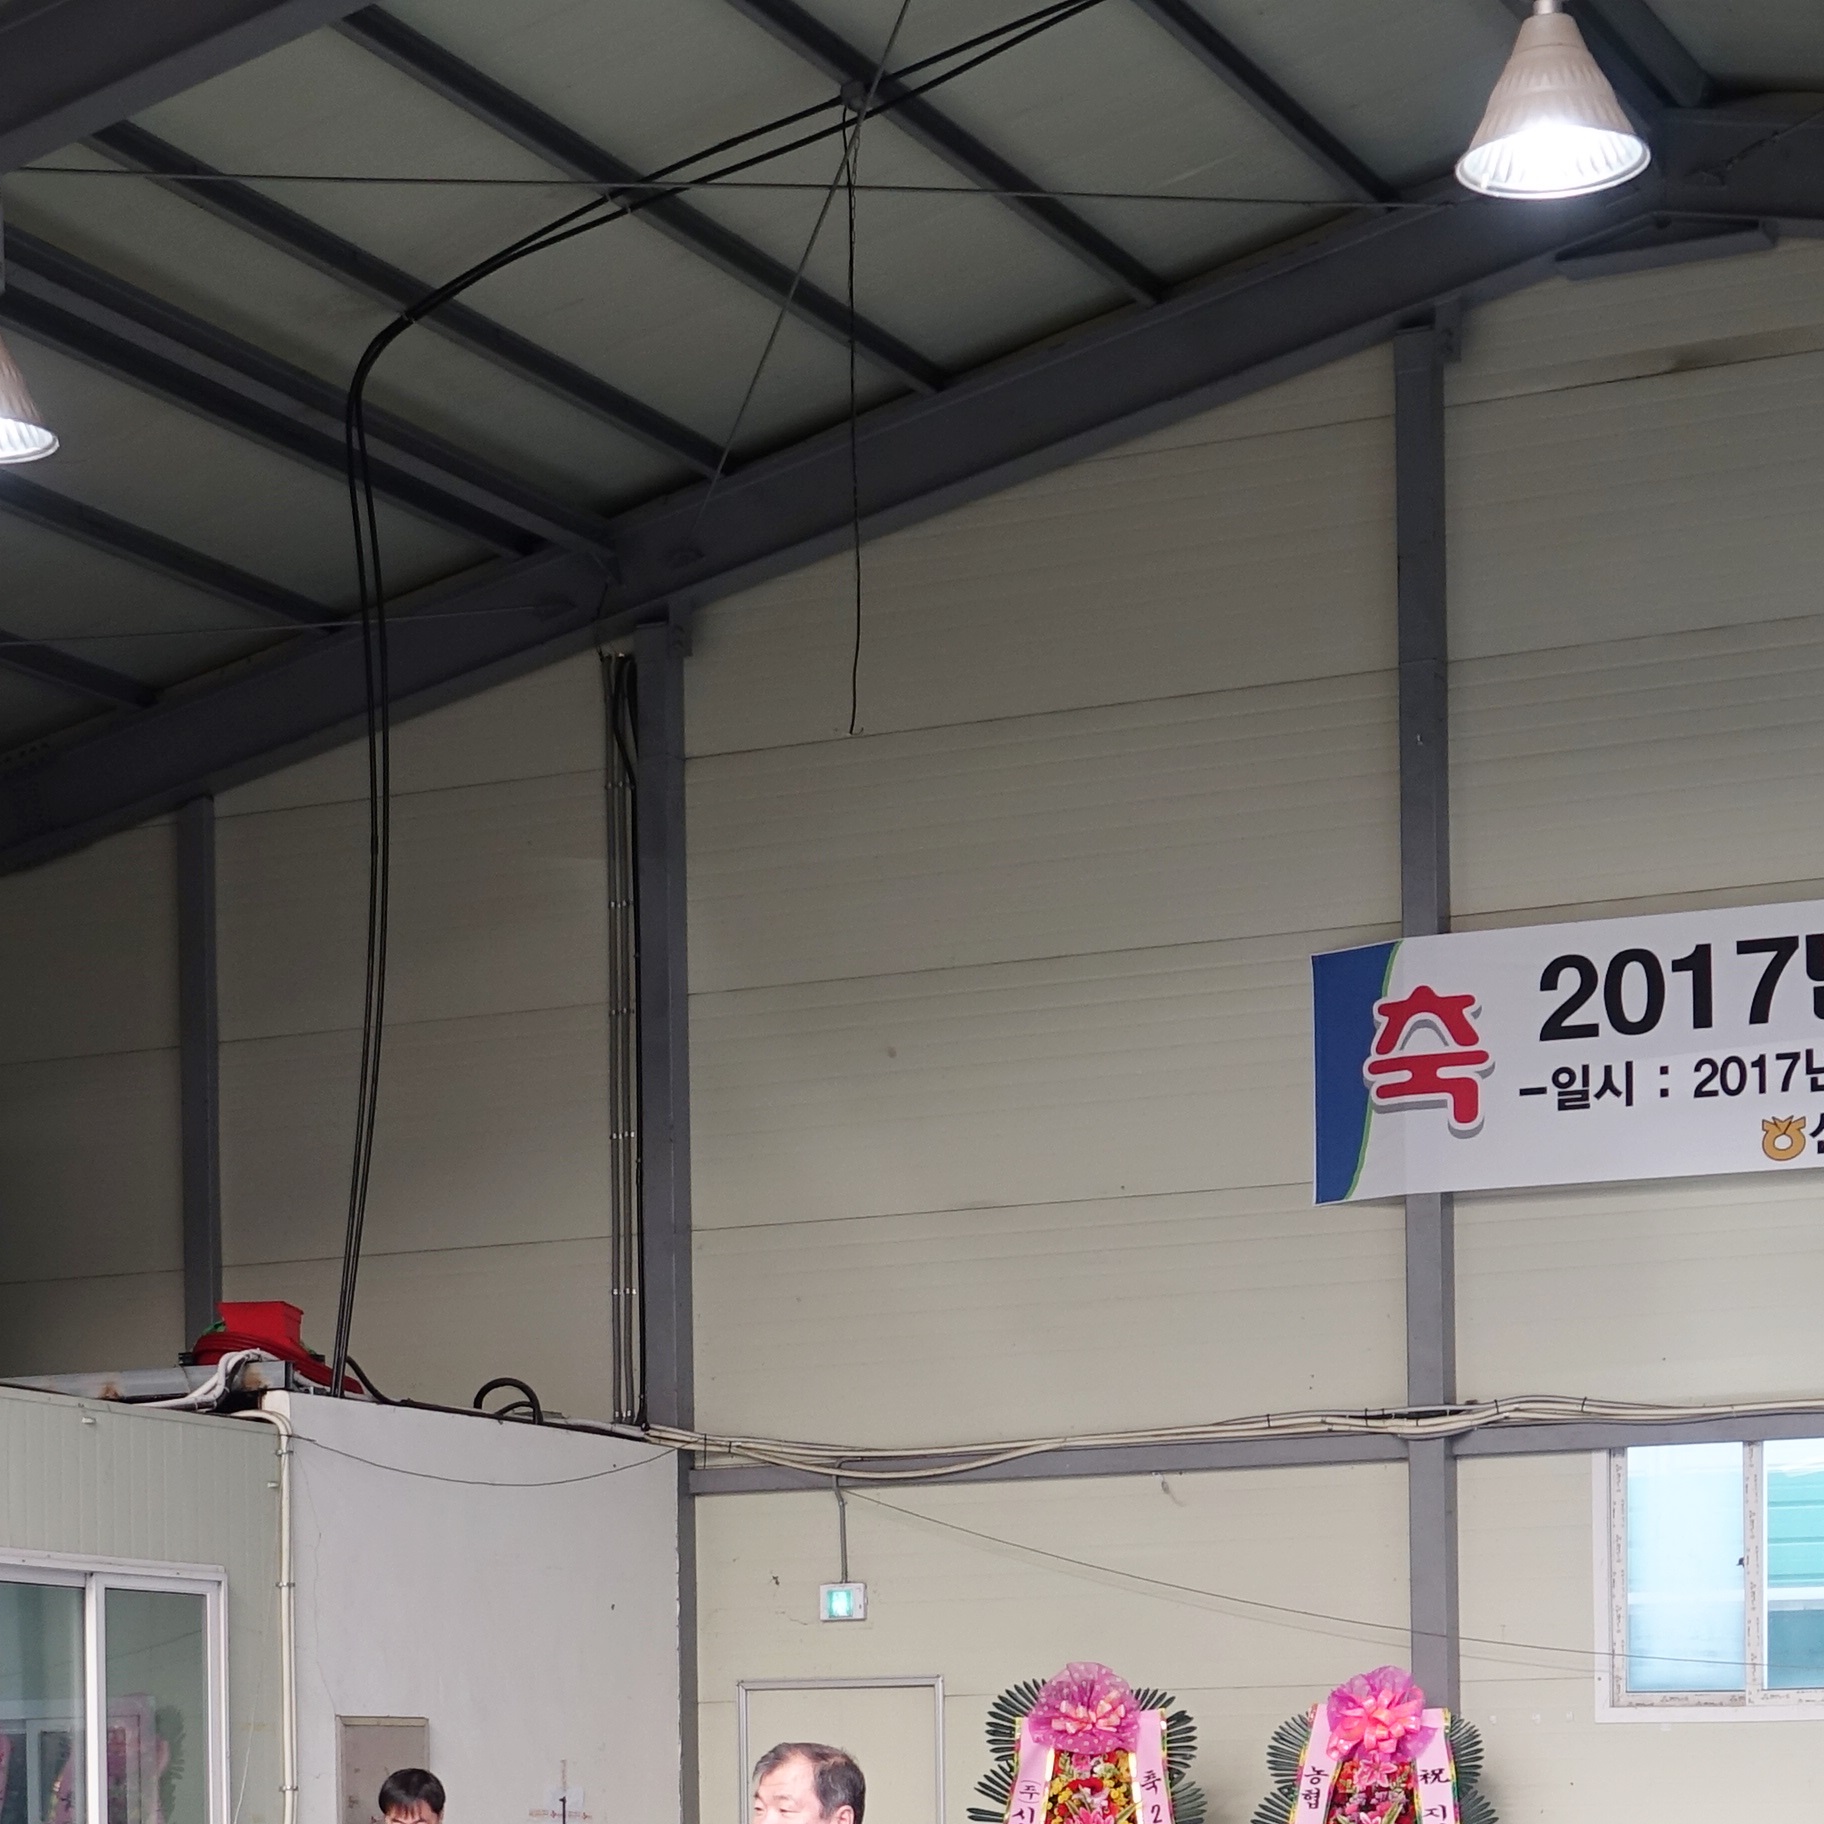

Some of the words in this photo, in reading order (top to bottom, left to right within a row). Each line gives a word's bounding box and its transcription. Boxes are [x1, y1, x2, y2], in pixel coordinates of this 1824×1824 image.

[1364, 984, 1493, 1131] 축
[1301, 1766, 1329, 1810] 농협
[1419, 1768, 1452, 1785] 祝
